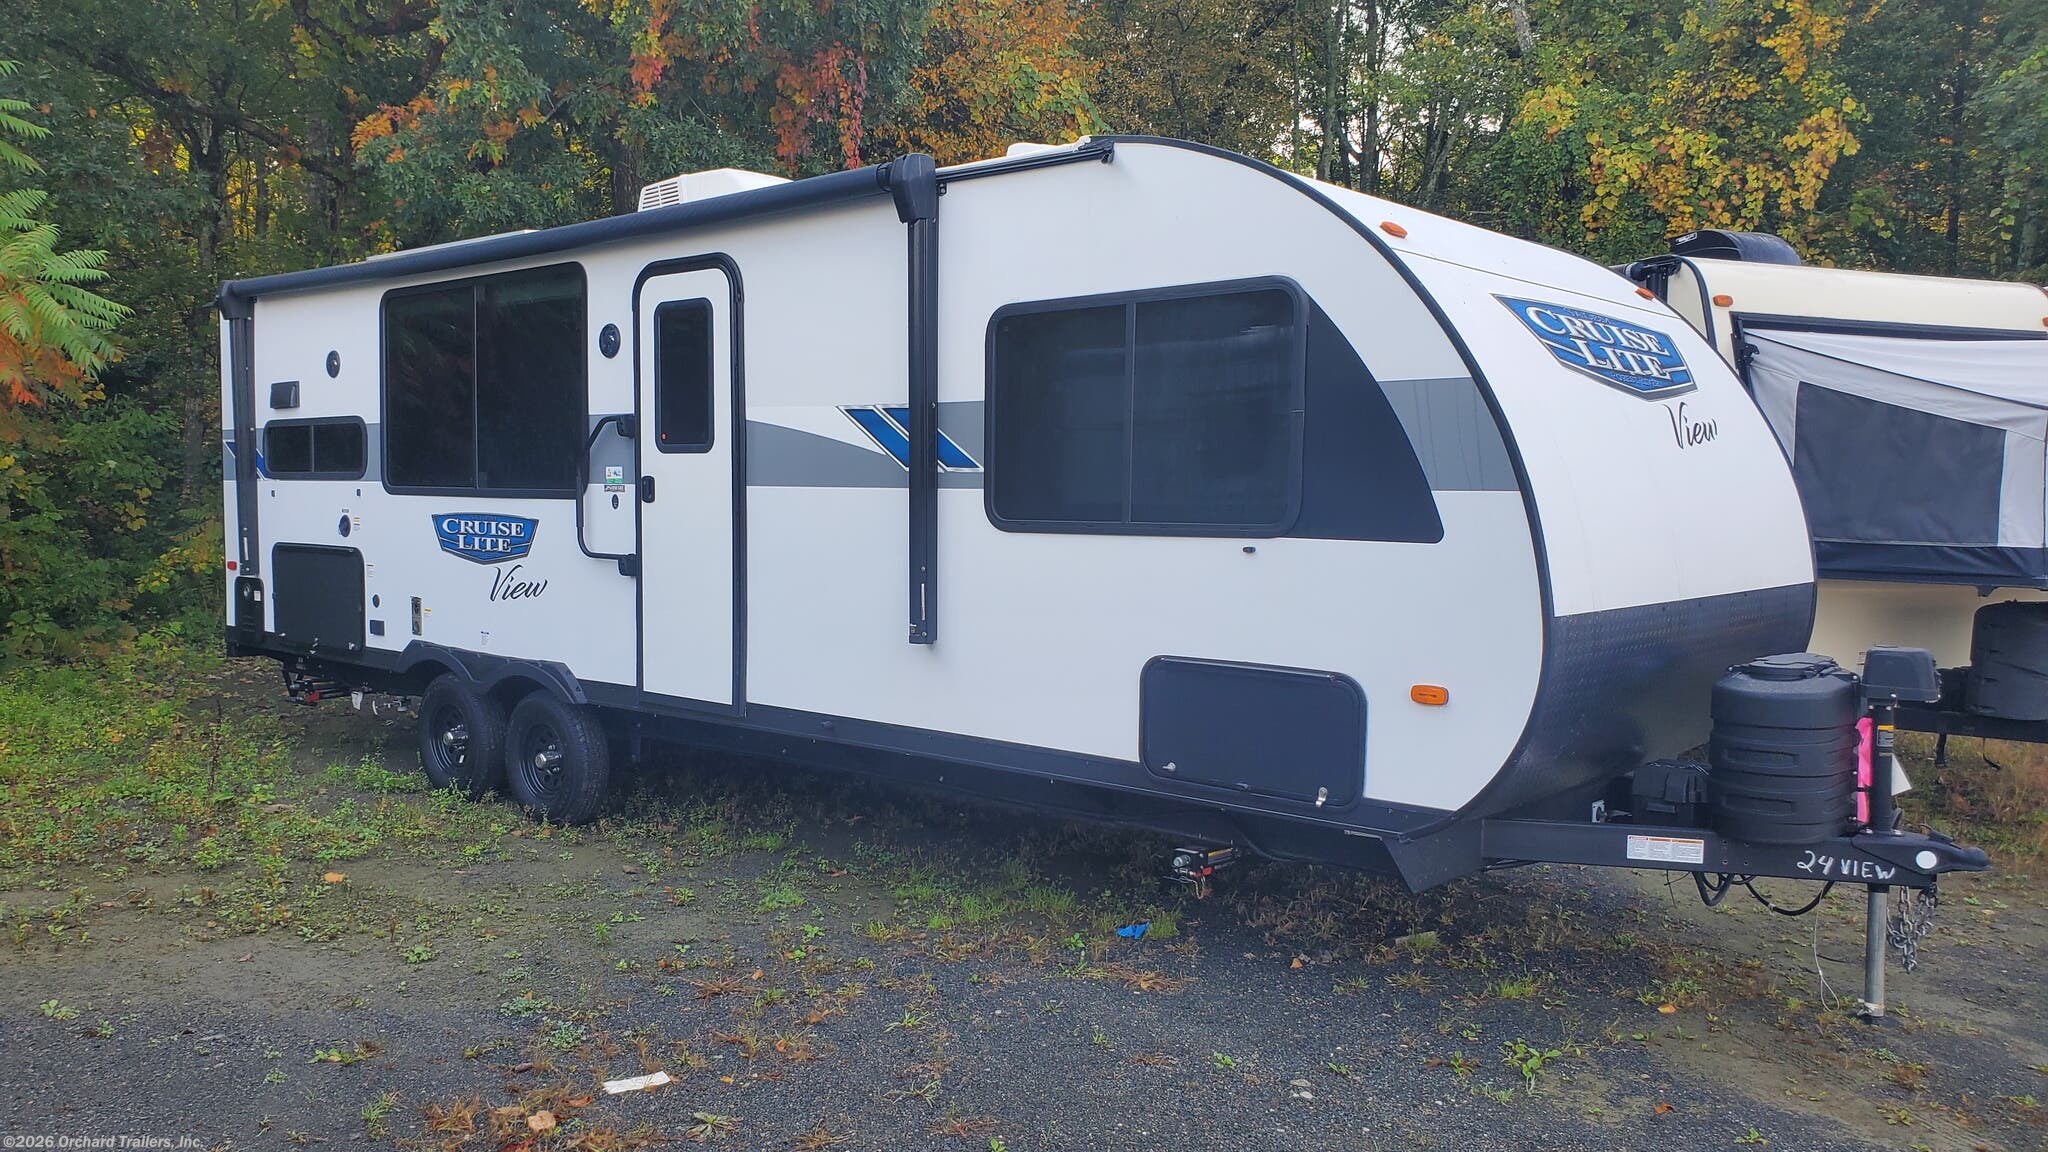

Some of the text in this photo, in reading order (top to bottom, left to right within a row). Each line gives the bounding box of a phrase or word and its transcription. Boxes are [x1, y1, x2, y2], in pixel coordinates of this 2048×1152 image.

[1526, 306, 1671, 358] CRUISE
[1570, 337, 1672, 381] LITE
[1660, 401, 1718, 450] View
[442, 518, 525, 537] CRUISE
[457, 534, 512, 553] LITE
[489, 564, 549, 602] View
[1796, 849, 1896, 880] 24 VIEW
